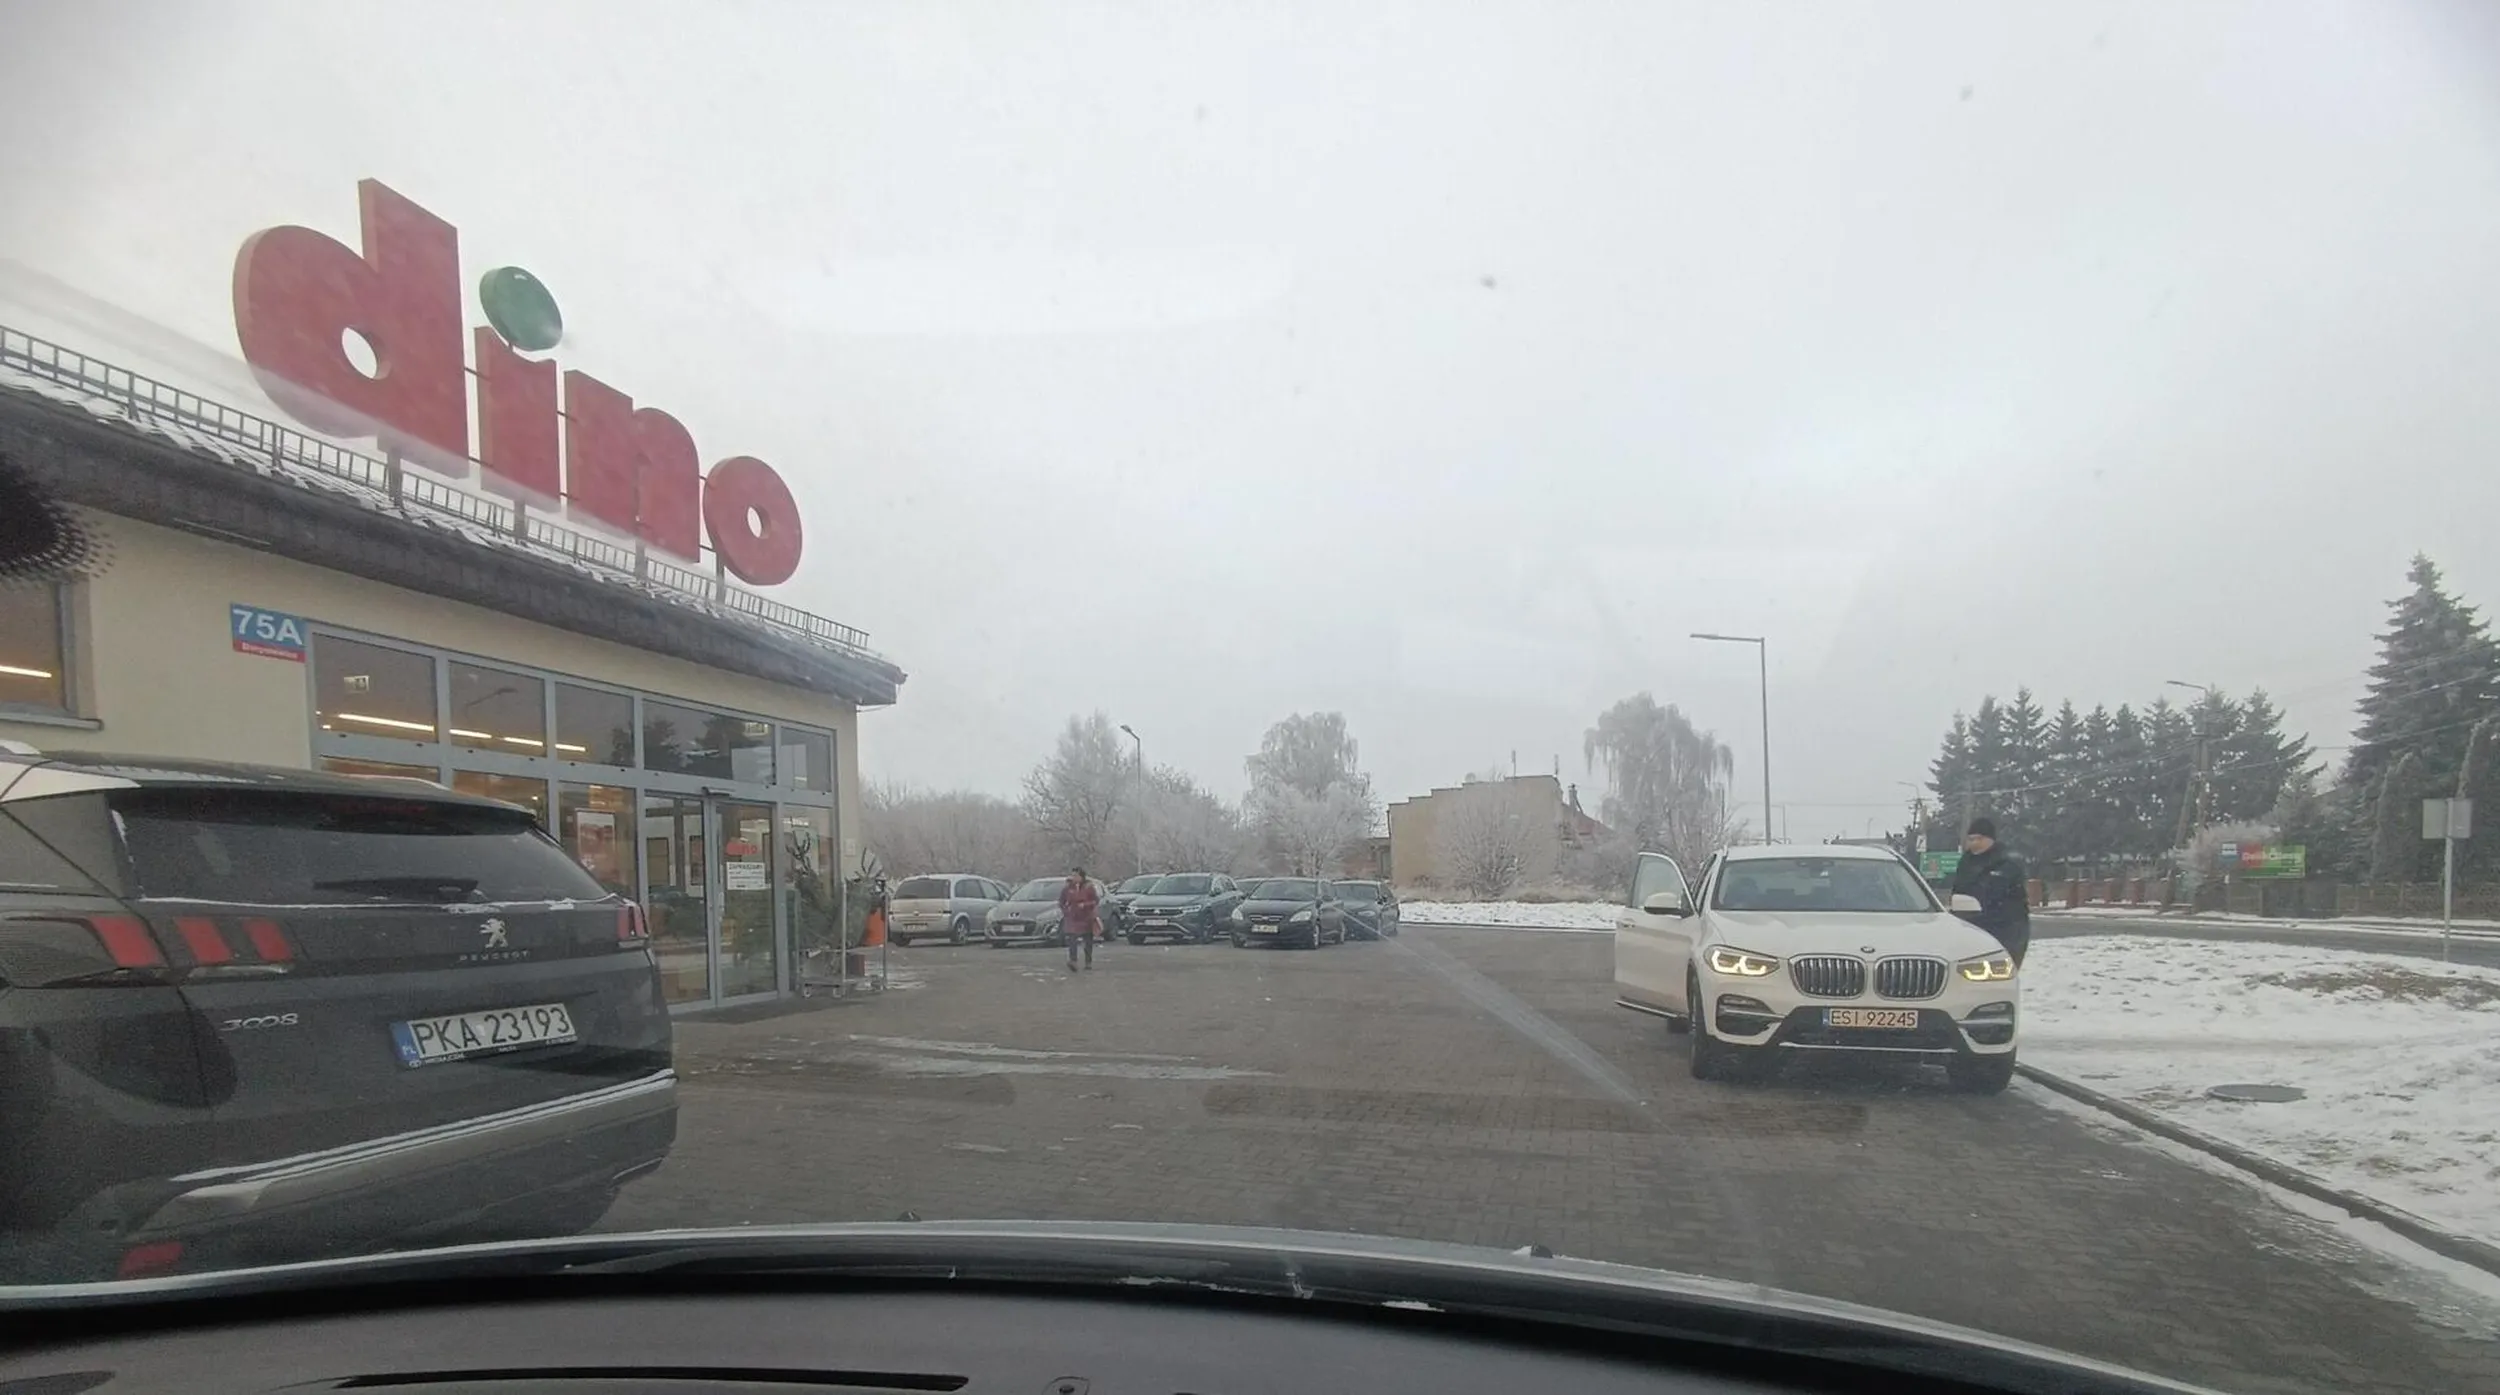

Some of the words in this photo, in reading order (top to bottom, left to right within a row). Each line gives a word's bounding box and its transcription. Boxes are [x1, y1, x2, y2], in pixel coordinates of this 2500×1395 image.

[233, 178, 803, 586] dino
[232, 608, 303, 645] 75A
[459, 950, 530, 961] PEUGEOT
[219, 1012, 298, 1031] 3008
[411, 1018, 481, 1055] PKA
[484, 1007, 571, 1044] 23193
[1831, 1010, 1858, 1025] ESI
[1866, 1011, 1916, 1027] 92245
